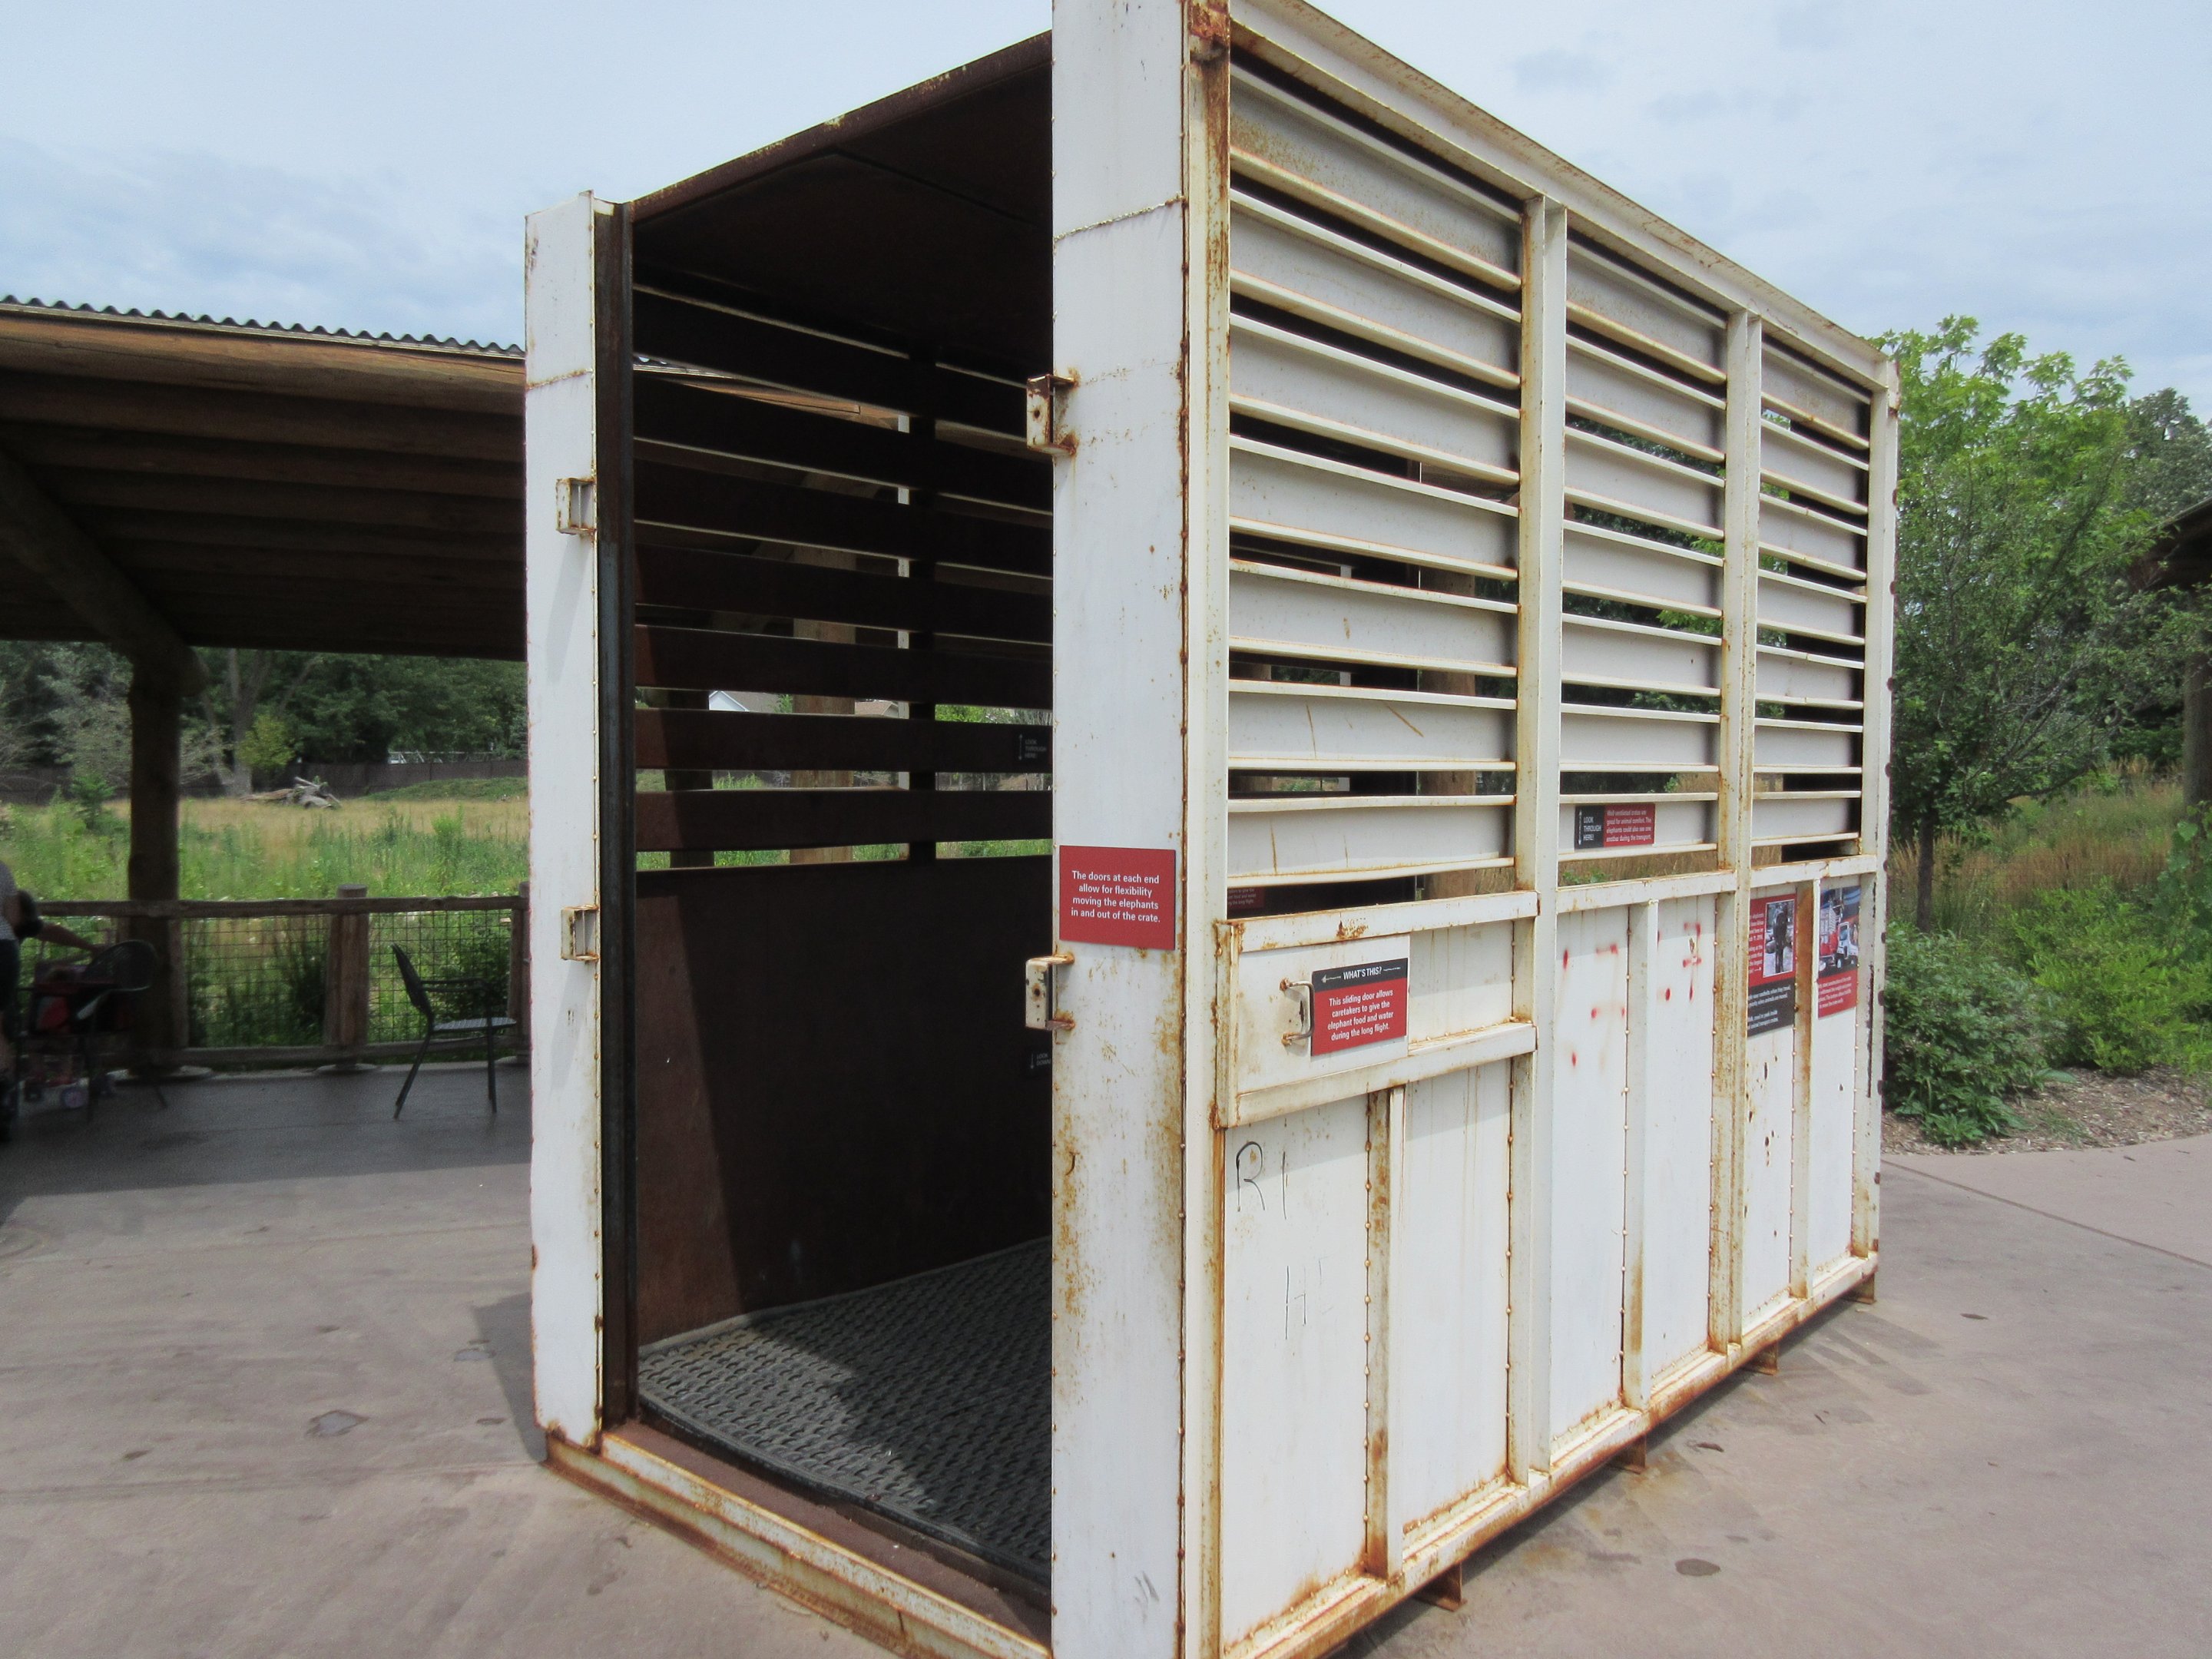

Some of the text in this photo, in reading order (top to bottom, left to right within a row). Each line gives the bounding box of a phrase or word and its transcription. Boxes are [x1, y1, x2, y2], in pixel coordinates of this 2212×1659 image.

[1072, 870, 1086, 879] The
[1089, 872, 1111, 882] doors
[1124, 874, 1141, 883] each
[1144, 875, 1159, 884] end
[1079, 884, 1151, 898] allow for flexibility
[1073, 896, 1158, 909] moving the elephants
[1081, 909, 1094, 918] and
[1113, 911, 1120, 919] of
[1123, 912, 1135, 920] the
[1138, 914, 1160, 922] crate.
[1343, 967, 1382, 980] WHAT'S THIS?
[1330, 989, 1392, 1007] This sliding door allows
[1332, 1006, 1360, 1018] caretakers
[1369, 1003, 1379, 1012] give
[1328, 1012, 1393, 1031] elephant food and water
[1331, 1029, 1349, 1041] during
[1362, 1026, 1373, 1035] long
[1375, 1023, 1389, 1032] flight.
